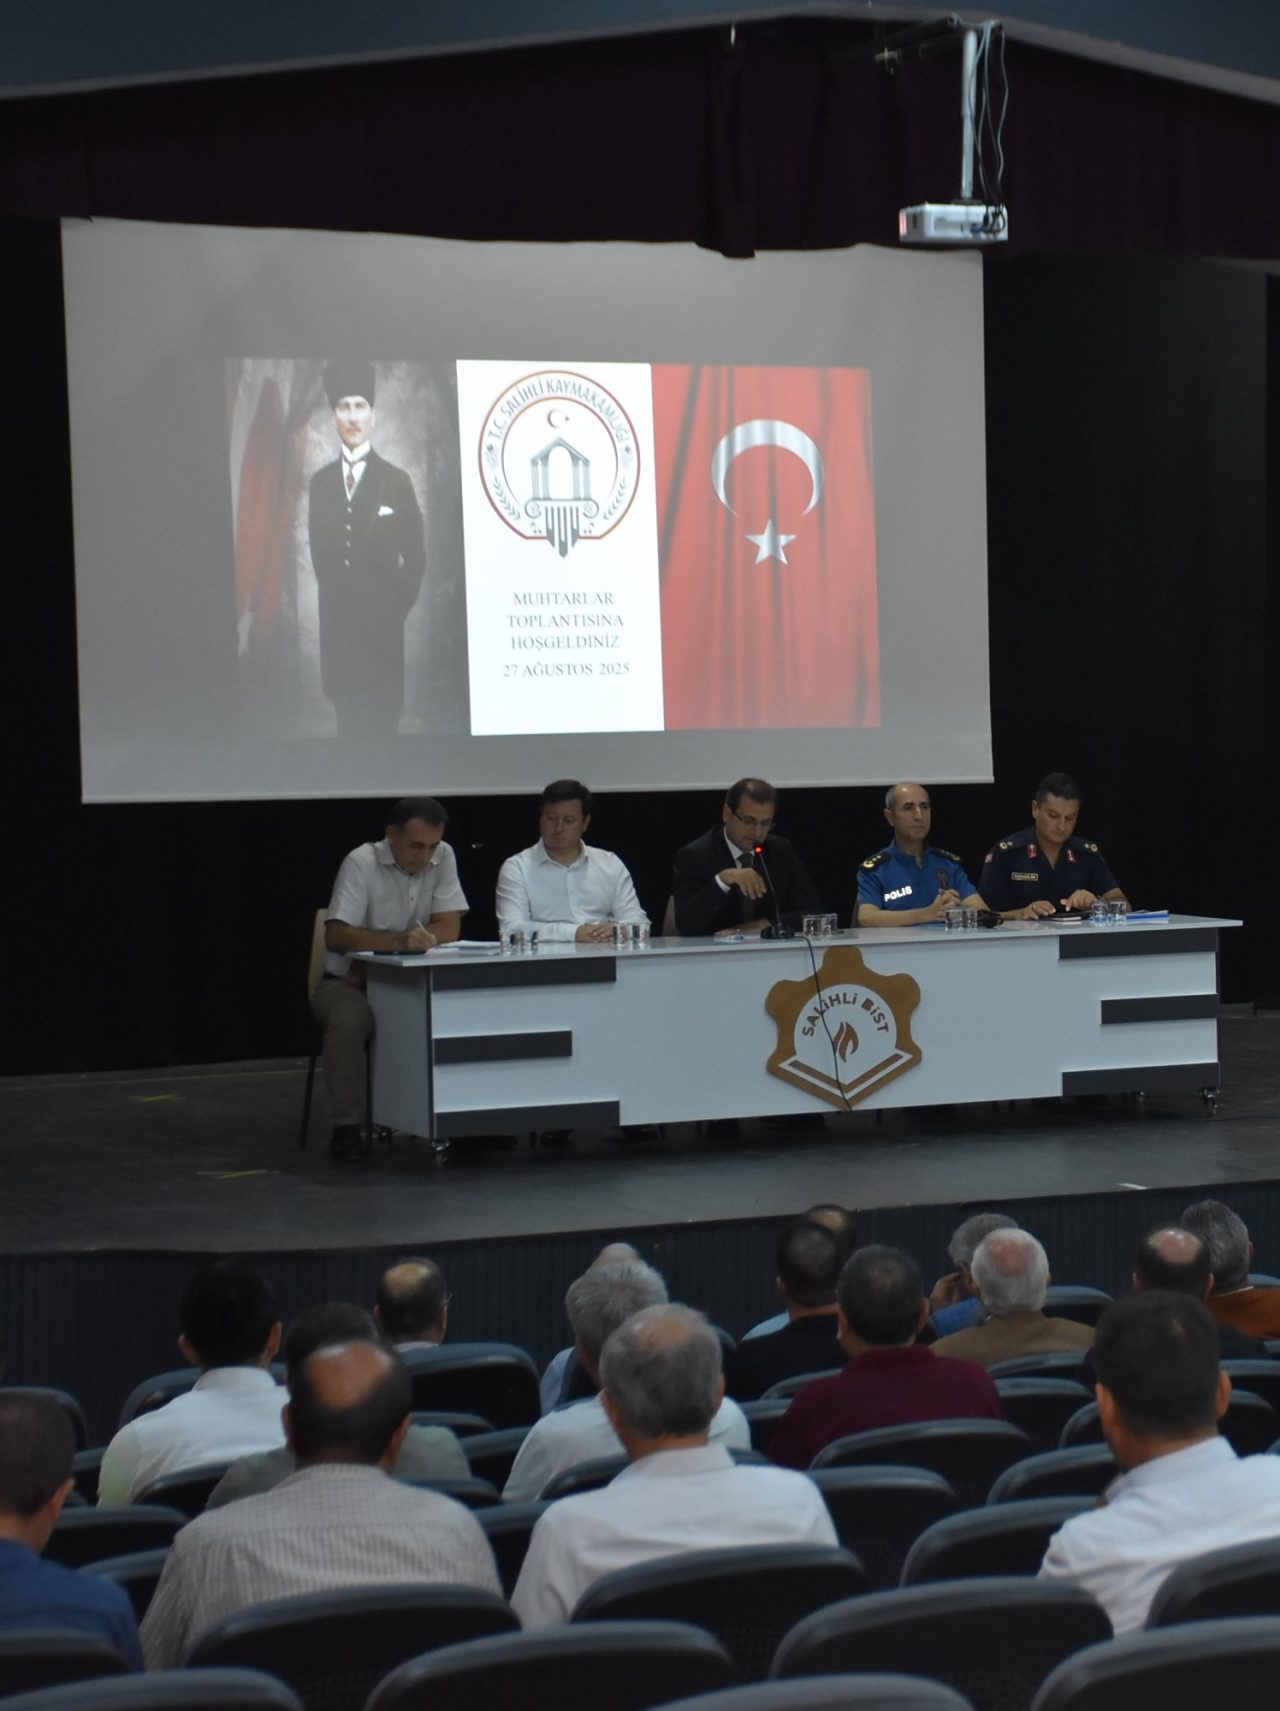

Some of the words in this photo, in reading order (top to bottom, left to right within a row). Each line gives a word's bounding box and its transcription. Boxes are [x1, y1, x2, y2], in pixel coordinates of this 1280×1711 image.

[500, 376, 545, 418] SALİHLİ
[513, 591, 614, 605] MUHTARLAR
[506, 613, 624, 628] TOPLANTISINA
[511, 632, 620, 652] HOŞGELDİNİZ
[503, 663, 519, 678] 27
[522, 661, 594, 677] AĞUSTOS
[599, 662, 631, 676] 2025
